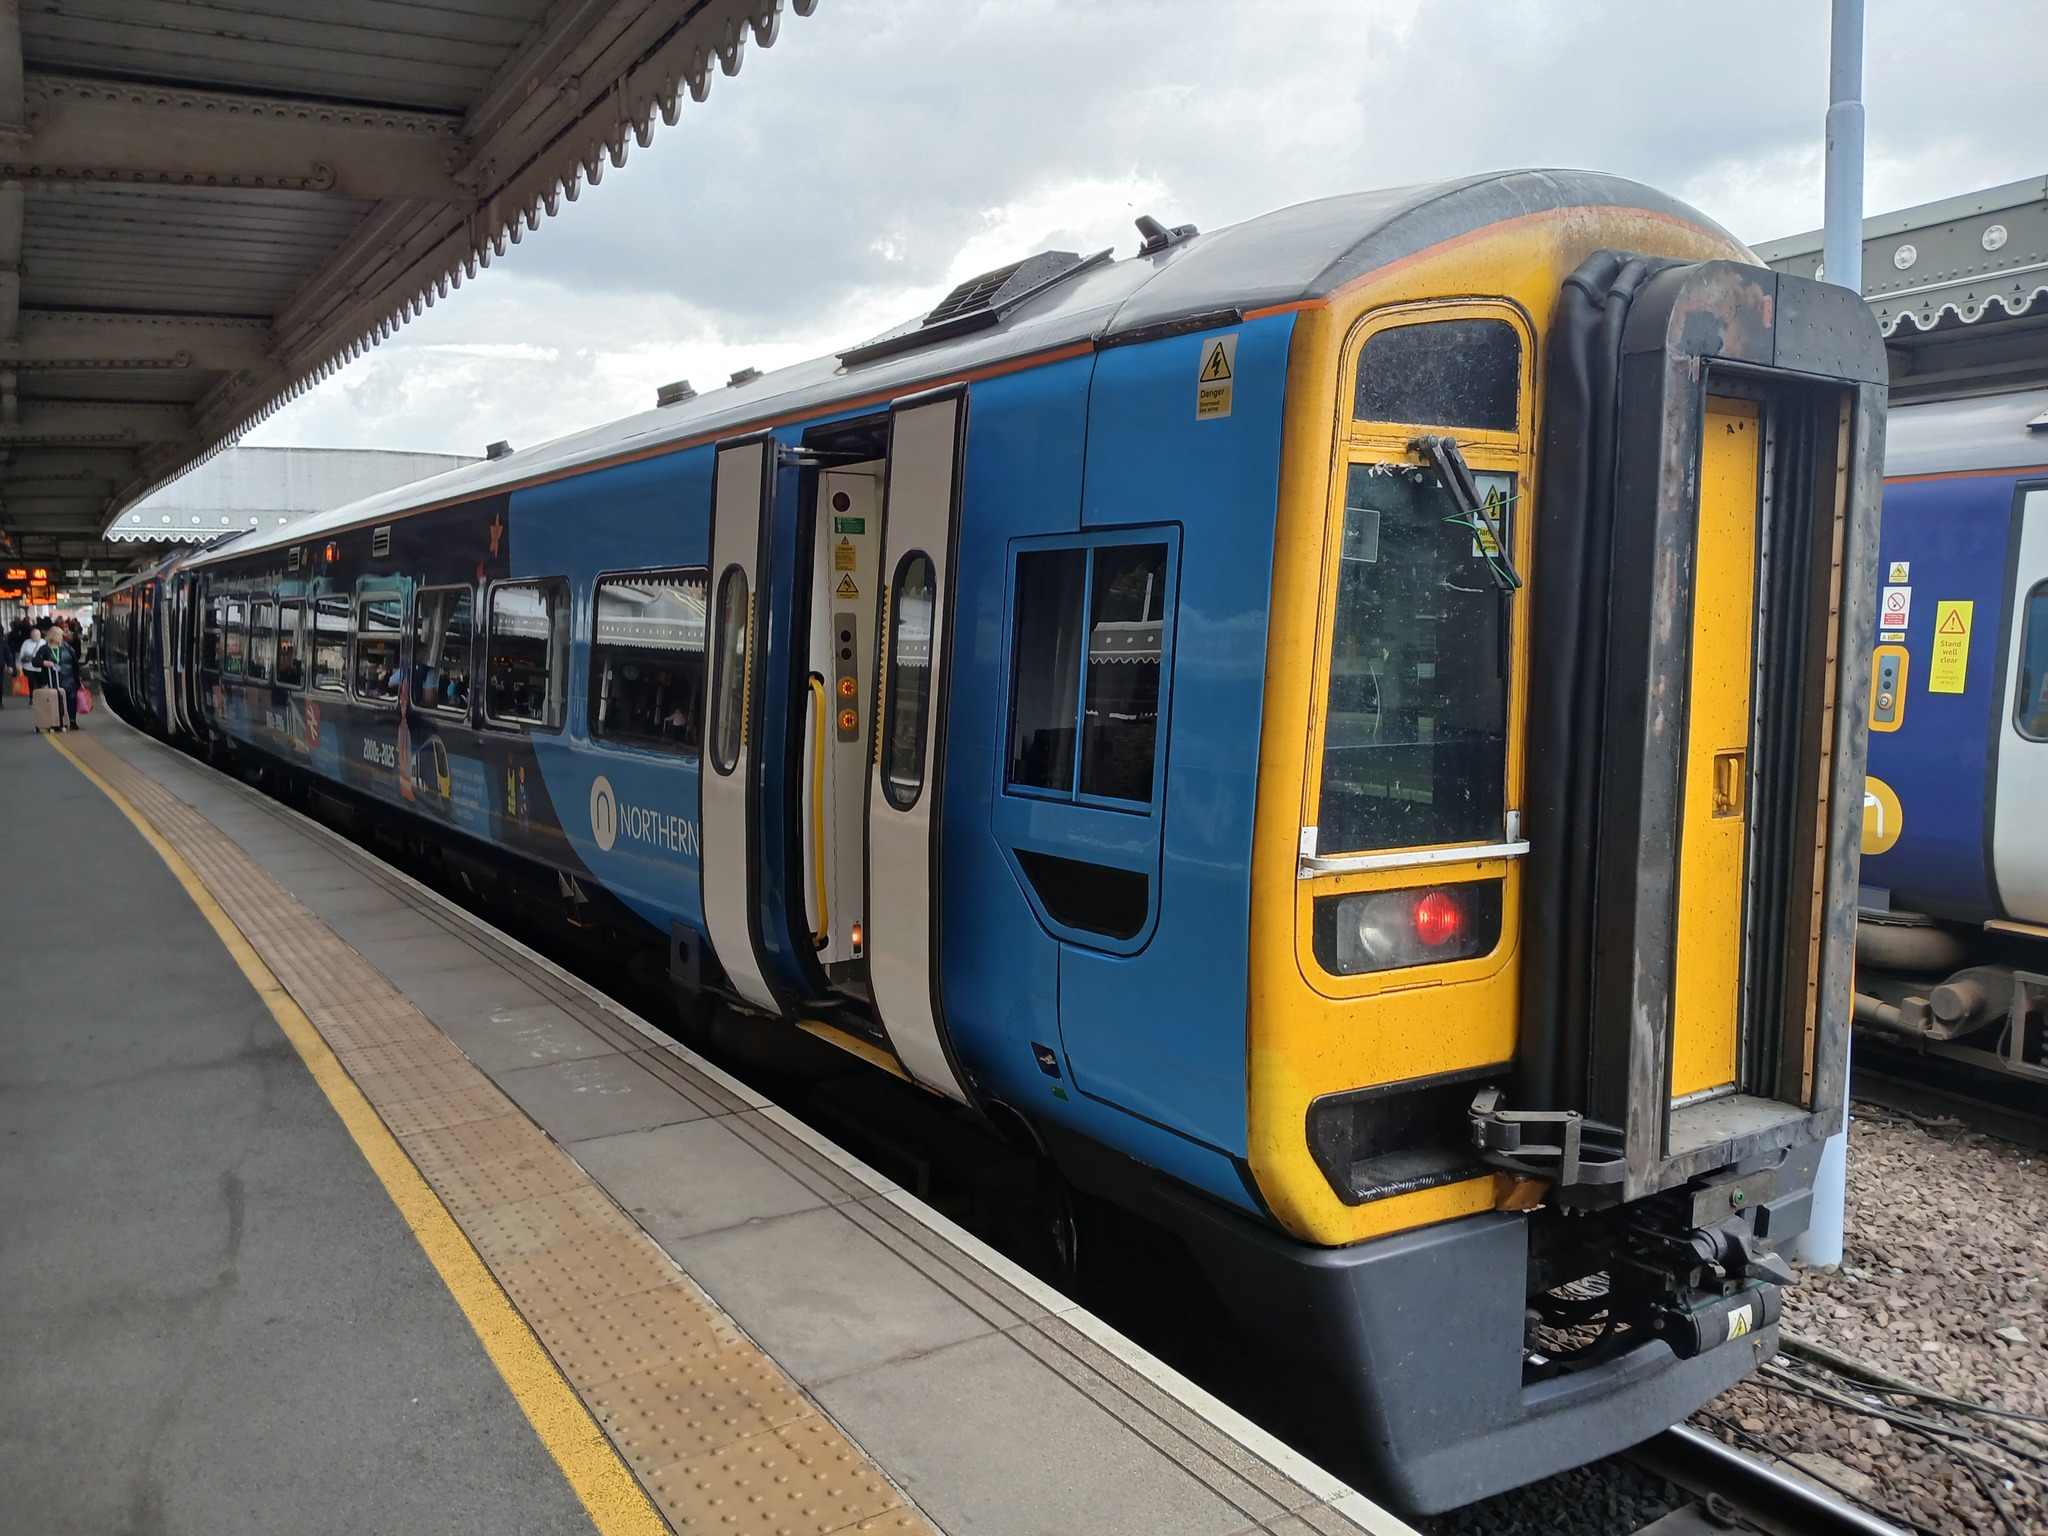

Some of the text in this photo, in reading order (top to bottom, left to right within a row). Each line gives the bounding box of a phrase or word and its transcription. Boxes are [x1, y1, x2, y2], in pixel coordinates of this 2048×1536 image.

[1200, 389, 1225, 399] Danger
[1940, 640, 1962, 648] Stand
[620, 803, 699, 857] NORTHERN
